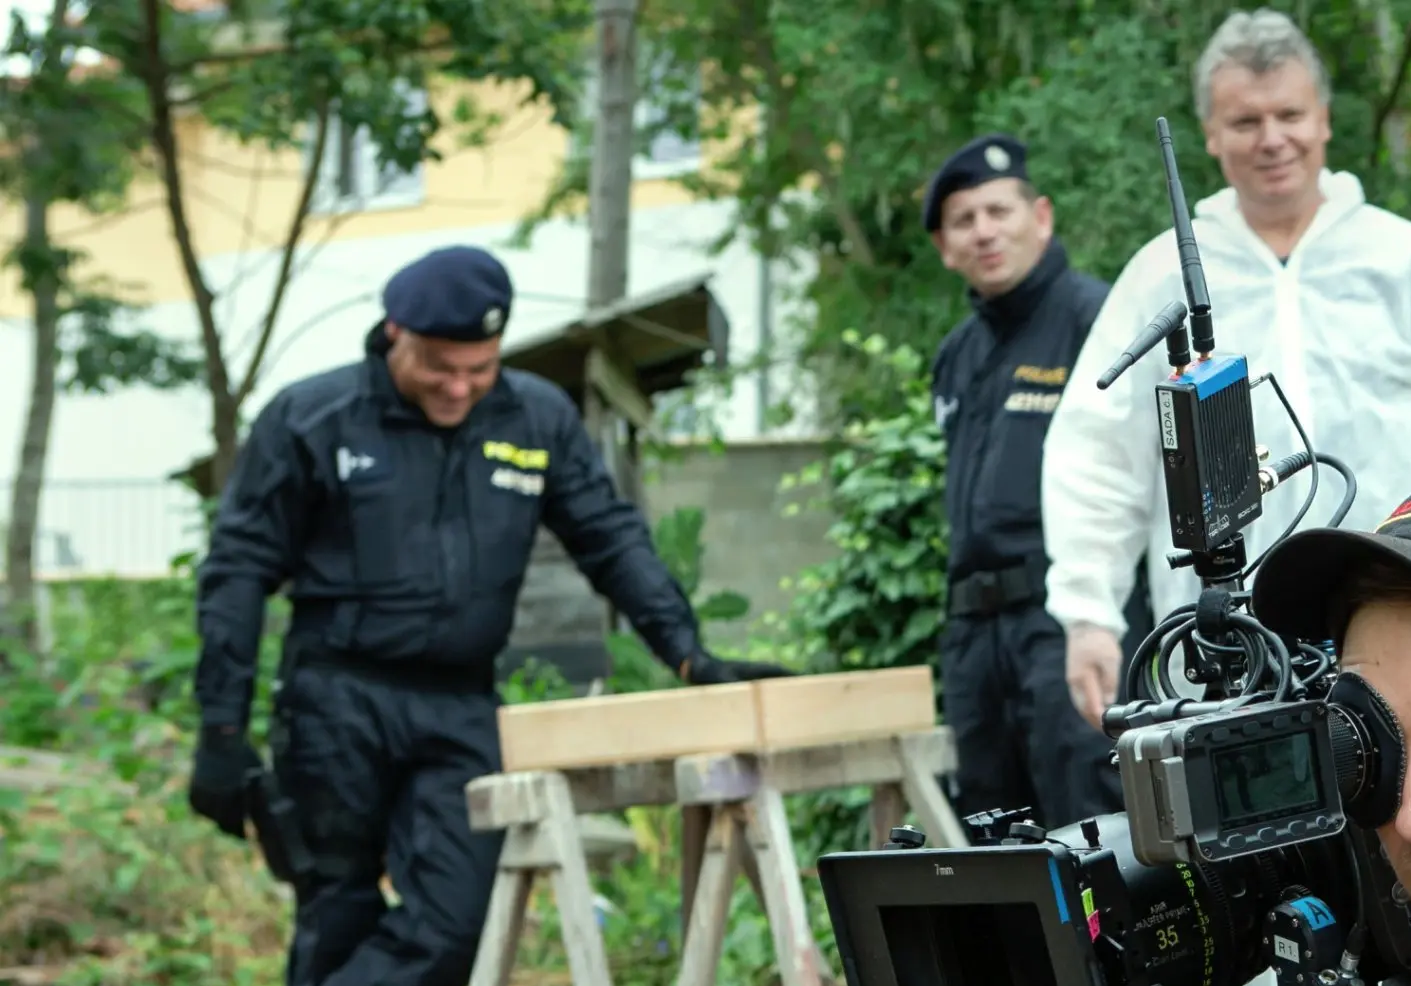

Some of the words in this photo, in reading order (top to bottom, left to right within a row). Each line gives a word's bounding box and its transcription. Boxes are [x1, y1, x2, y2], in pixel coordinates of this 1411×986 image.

[1164, 412, 1175, 446] SADA
[1304, 901, 1329, 924] A
[1156, 924, 1179, 950] 35
